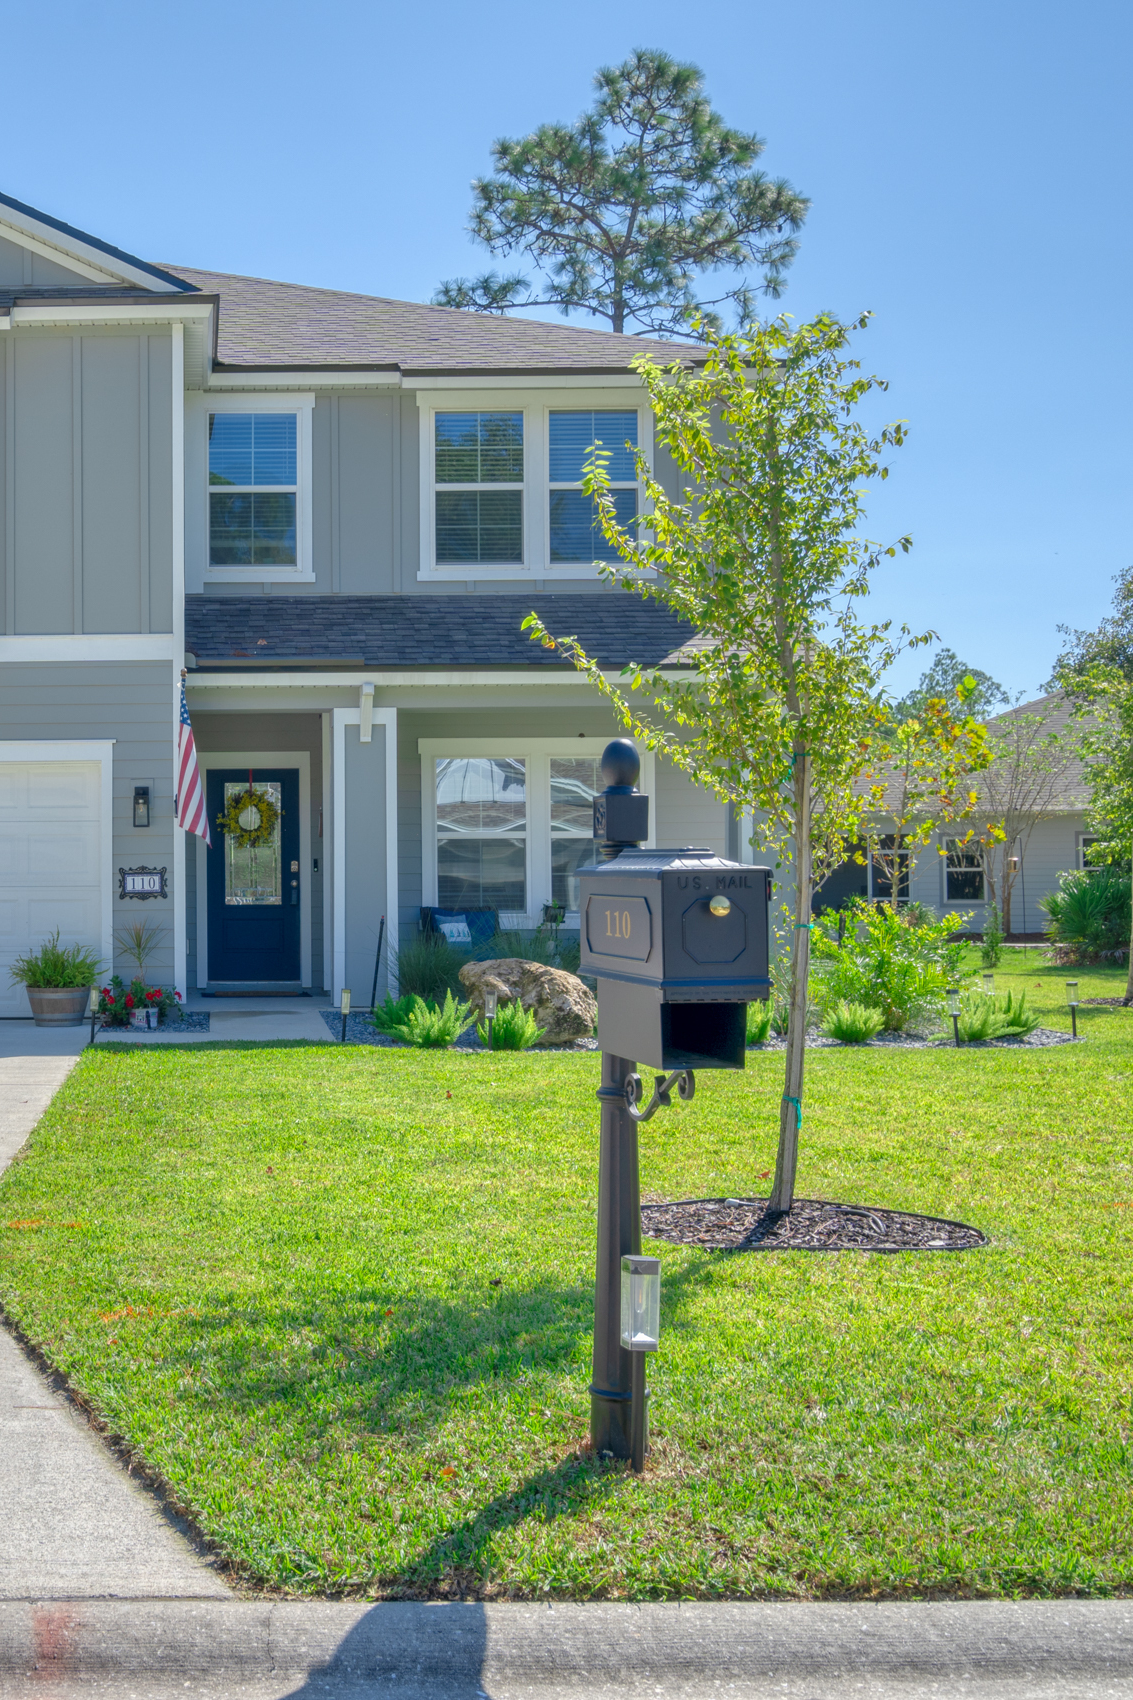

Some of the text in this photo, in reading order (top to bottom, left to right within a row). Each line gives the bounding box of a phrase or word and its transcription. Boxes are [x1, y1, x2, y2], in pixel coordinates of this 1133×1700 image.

[131, 877, 156, 889] 110
[677, 875, 753, 891] US MAIL
[604, 909, 631, 939] 110
